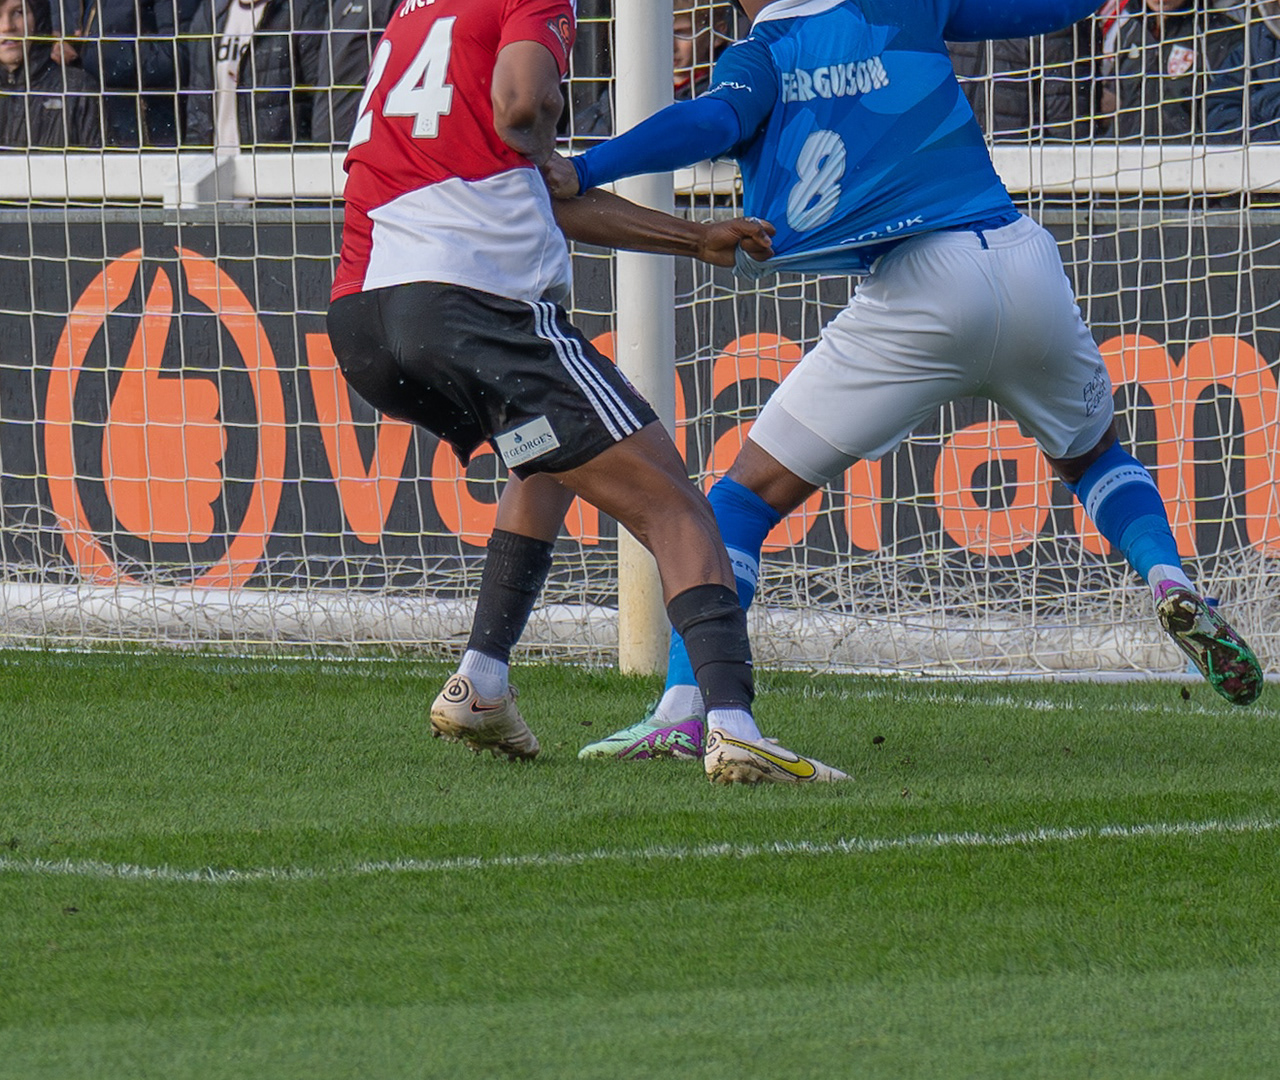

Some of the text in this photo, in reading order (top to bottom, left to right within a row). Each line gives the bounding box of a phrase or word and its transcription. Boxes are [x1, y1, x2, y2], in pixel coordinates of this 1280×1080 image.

[348, 15, 458, 150] 24
[781, 56, 890, 104] FERGUSON
[786, 129, 847, 233] 8
